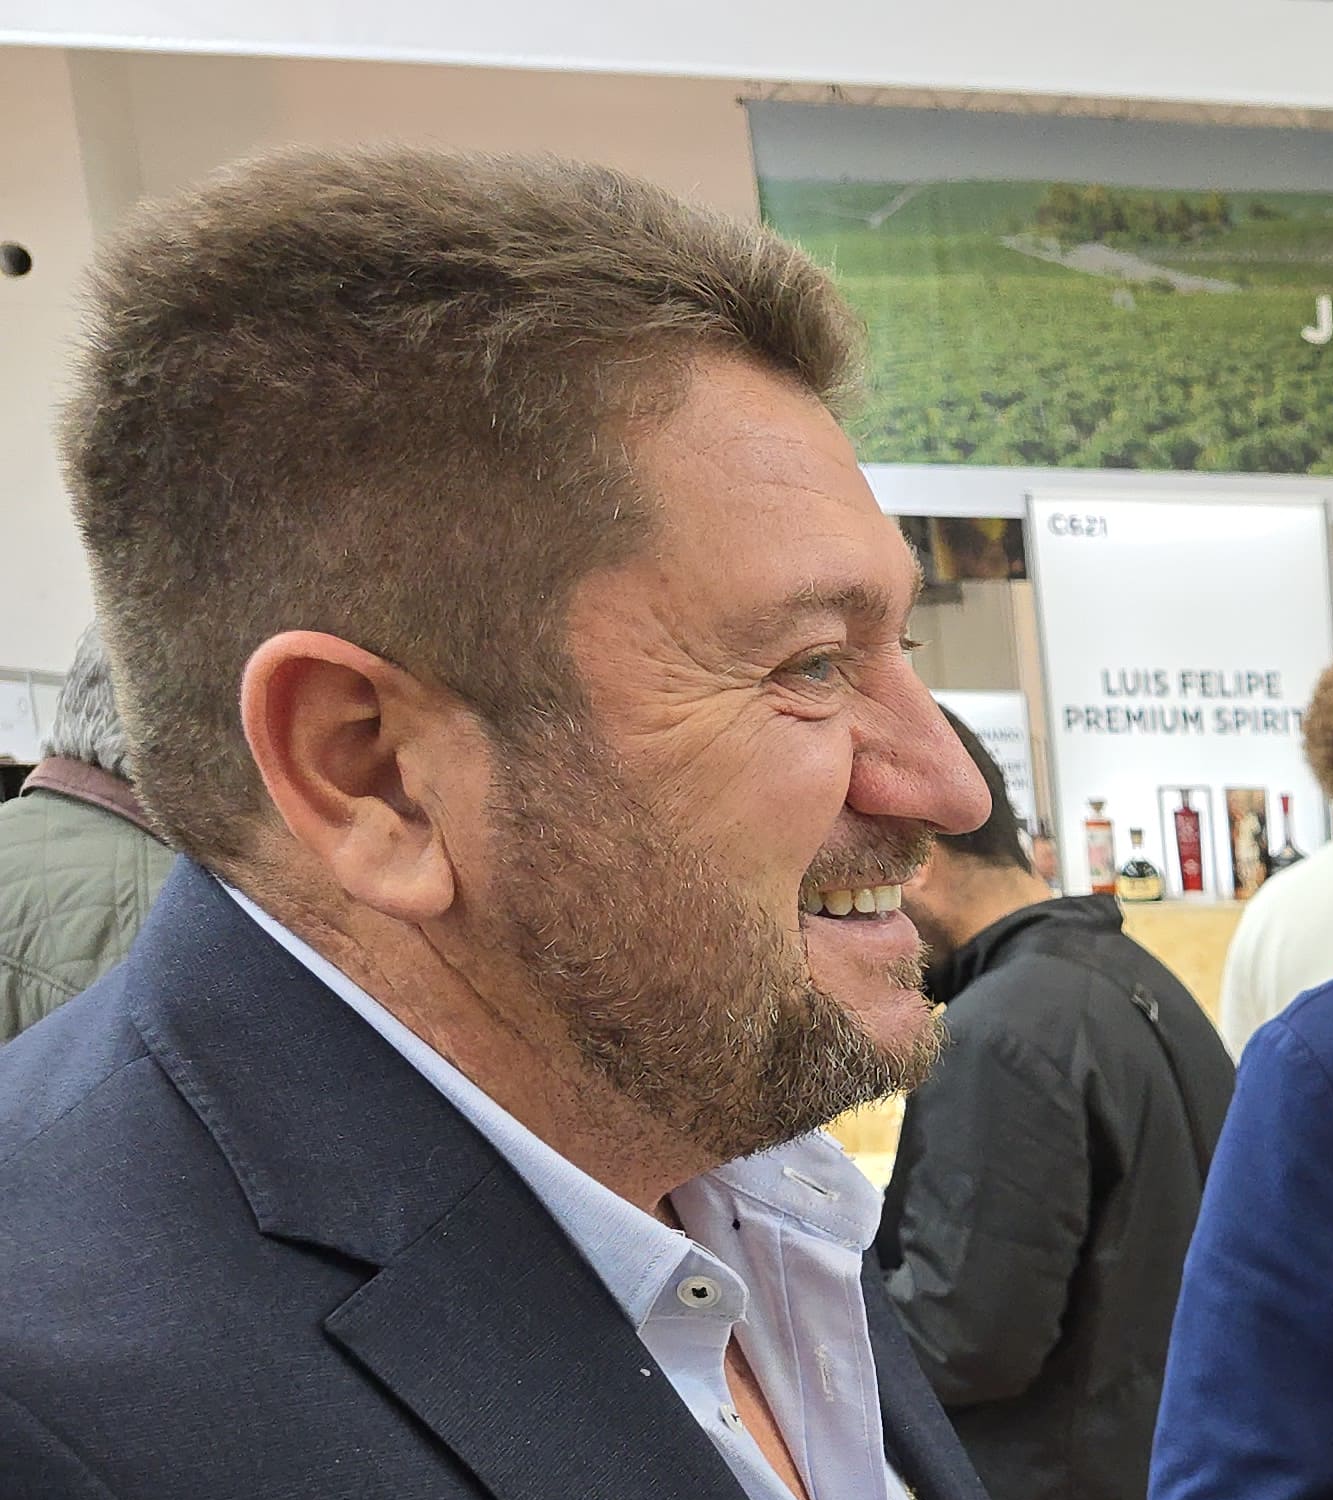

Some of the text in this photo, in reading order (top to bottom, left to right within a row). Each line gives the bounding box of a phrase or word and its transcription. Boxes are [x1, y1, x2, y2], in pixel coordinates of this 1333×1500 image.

[1102, 669, 1283, 699] LUIS FELIPE
[1064, 706, 1204, 735] PREMIUM
